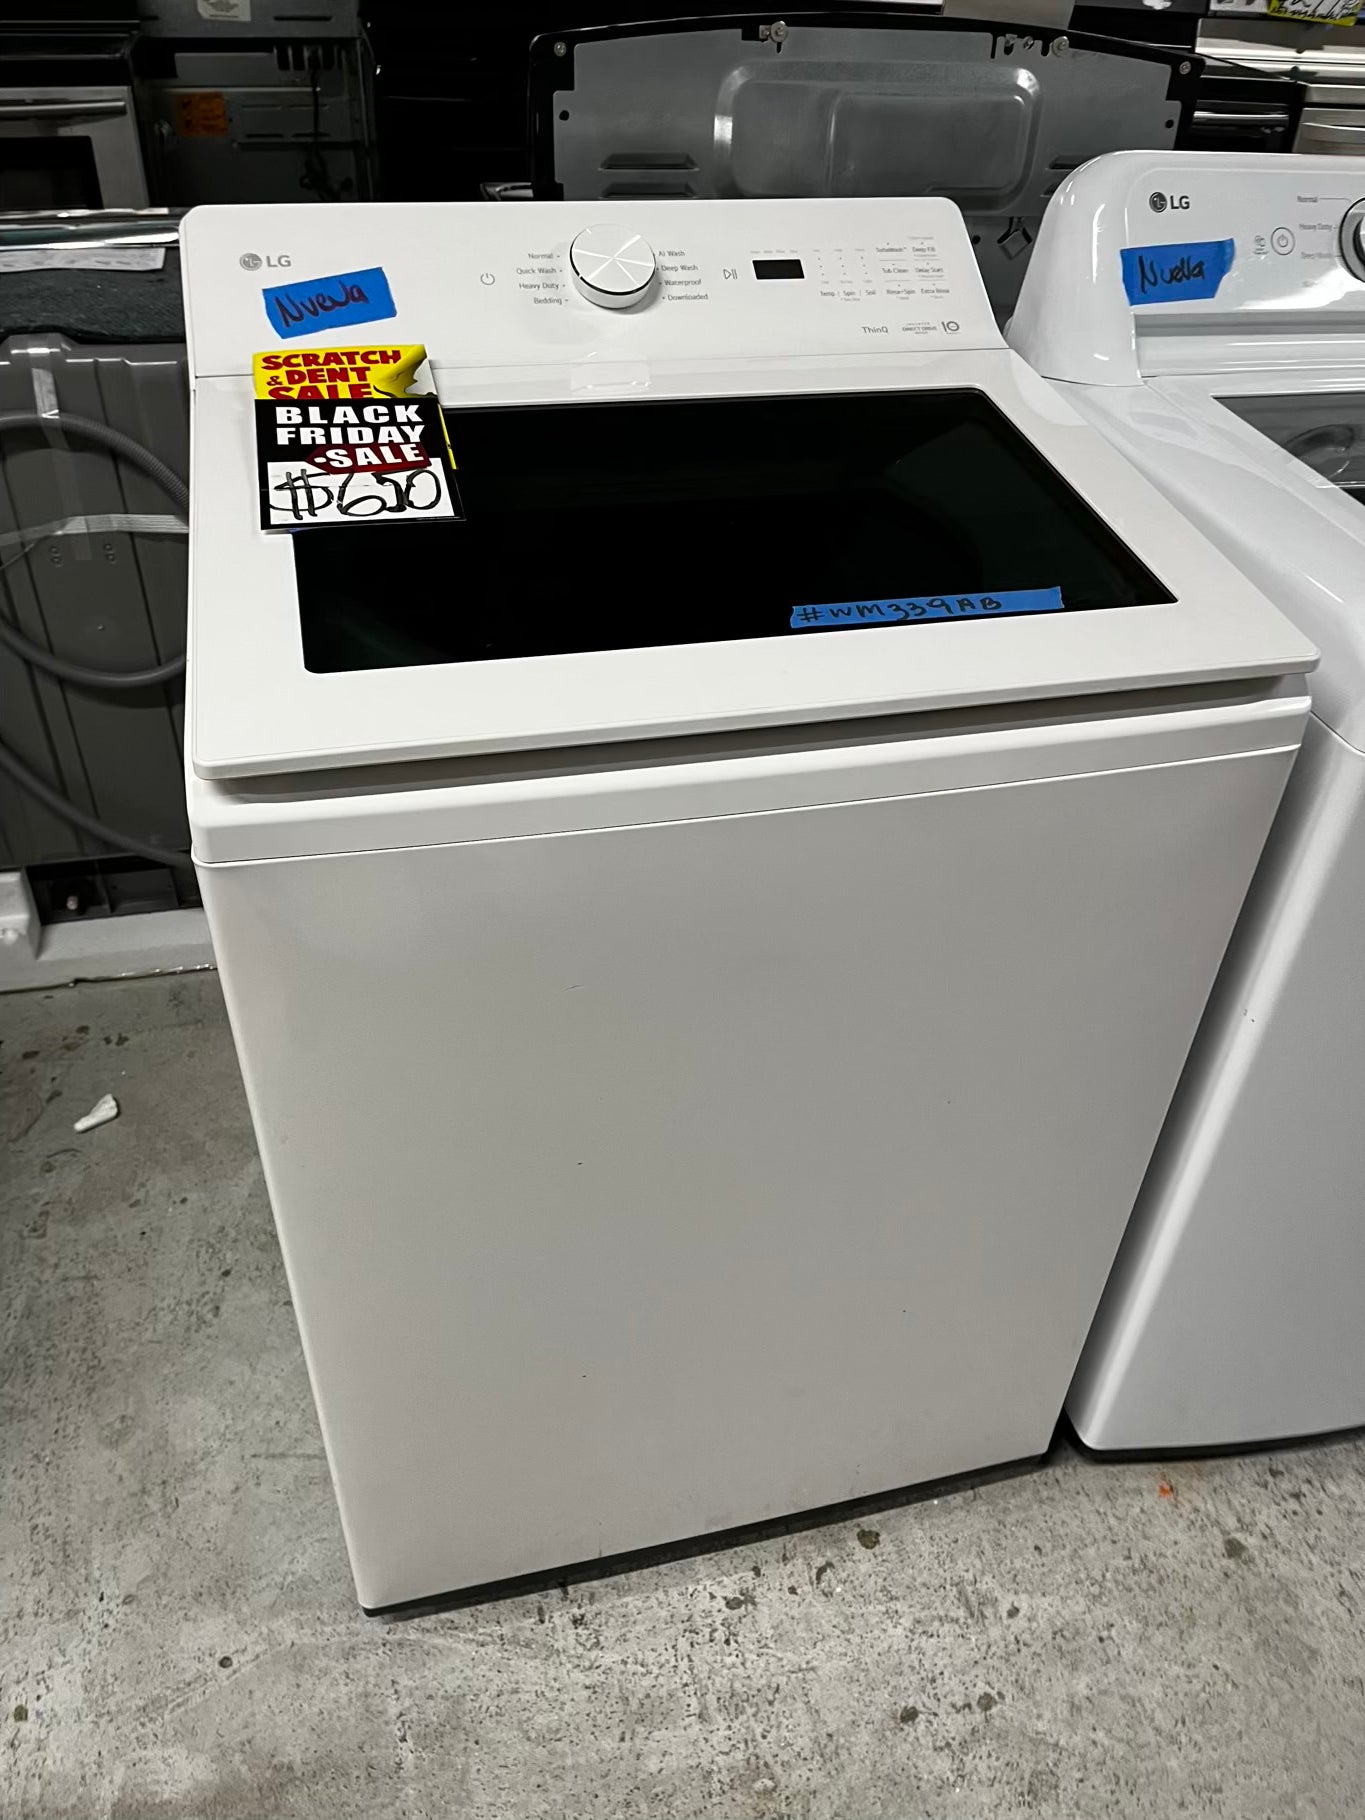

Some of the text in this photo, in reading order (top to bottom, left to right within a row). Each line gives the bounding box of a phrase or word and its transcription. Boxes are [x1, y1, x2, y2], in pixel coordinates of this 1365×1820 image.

[1170, 195, 1190, 210] LG
[667, 249, 686, 257] Wash
[266, 254, 292, 268] LG
[516, 267, 536, 275] Quick
[661, 265, 679, 273] Deep
[519, 282, 560, 290] Heavy Duty
[664, 278, 702, 286] Waterproof
[533, 297, 563, 305] Bedding
[667, 293, 709, 301] Downloaded
[861, 325, 889, 334] ThinQ
[261, 350, 401, 371] SCRATCH
[266, 366, 371, 387] & DENT
[268, 383, 374, 400] SALE
[275, 405, 423, 424] BLACK
[276, 425, 425, 445] FRIDAY
[325, 443, 424, 468] SALE
